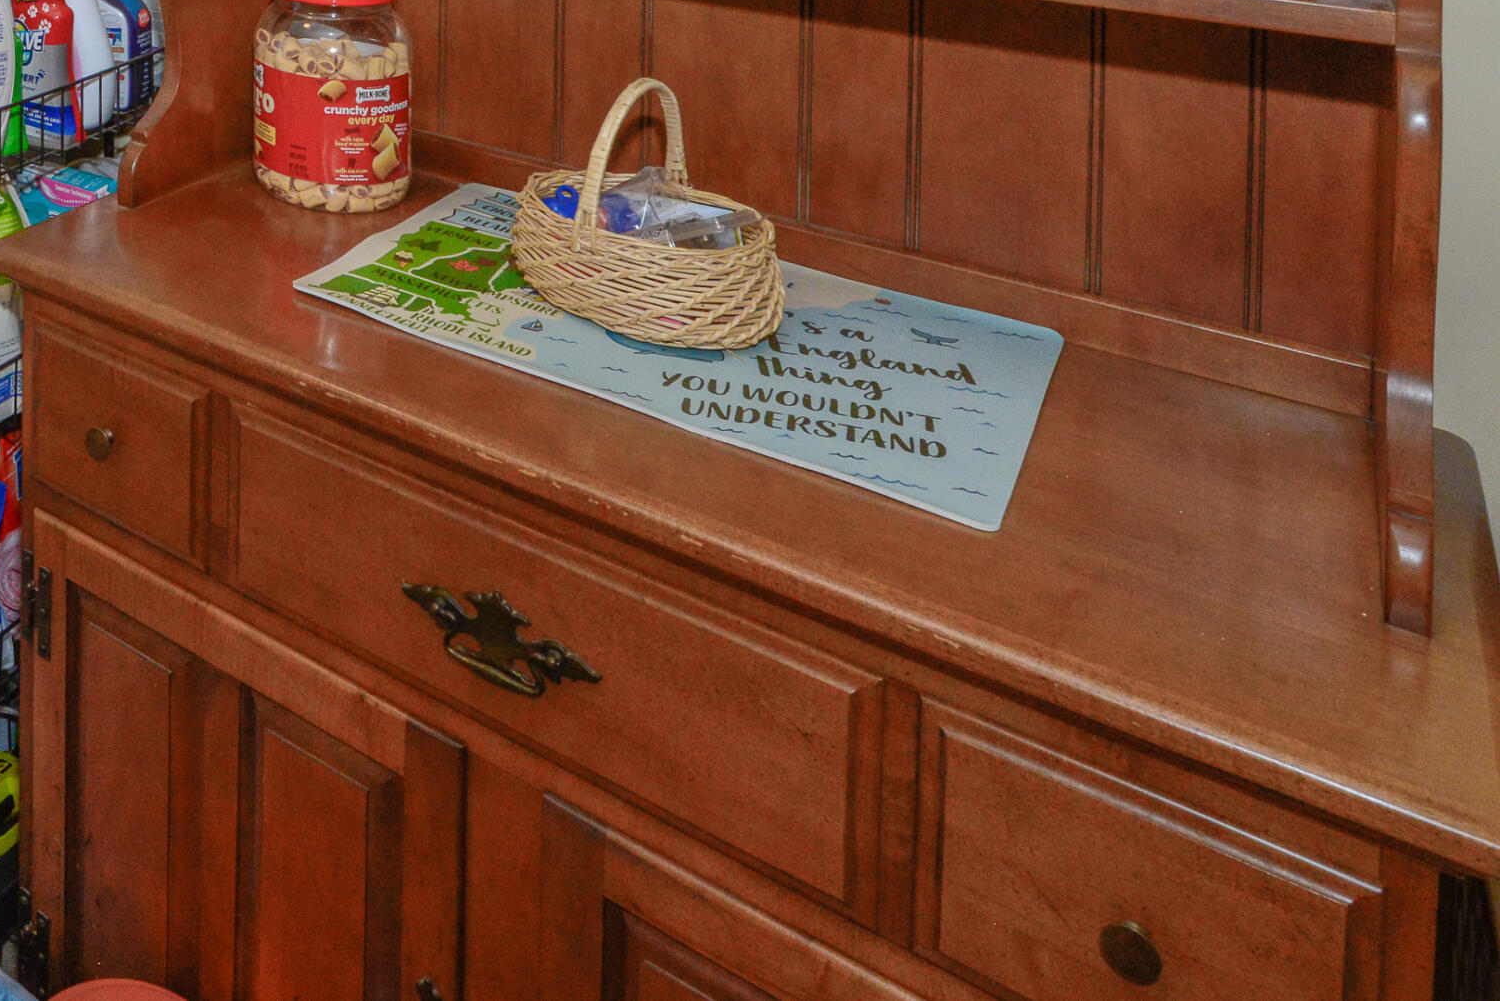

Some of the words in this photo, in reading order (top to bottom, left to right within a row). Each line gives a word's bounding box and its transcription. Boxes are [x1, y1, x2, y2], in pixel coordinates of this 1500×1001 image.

[358, 89, 388, 99] MILK-BONE
[324, 105, 369, 117] crunchy
[370, 100, 408, 116] goodness
[348, 116, 377, 126] every
[378, 113, 395, 125] day
[424, 225, 494, 248] VERMONT
[372, 267, 504, 315] MASSACHUSETTS
[410, 311, 466, 336] RHODE
[468, 331, 533, 358] ISLAND
[841, 327, 874, 342] a
[662, 371, 731, 395] YOU
[742, 384, 941, 432] WOULDN'T
[681, 397, 947, 458] UNDERSTAND
